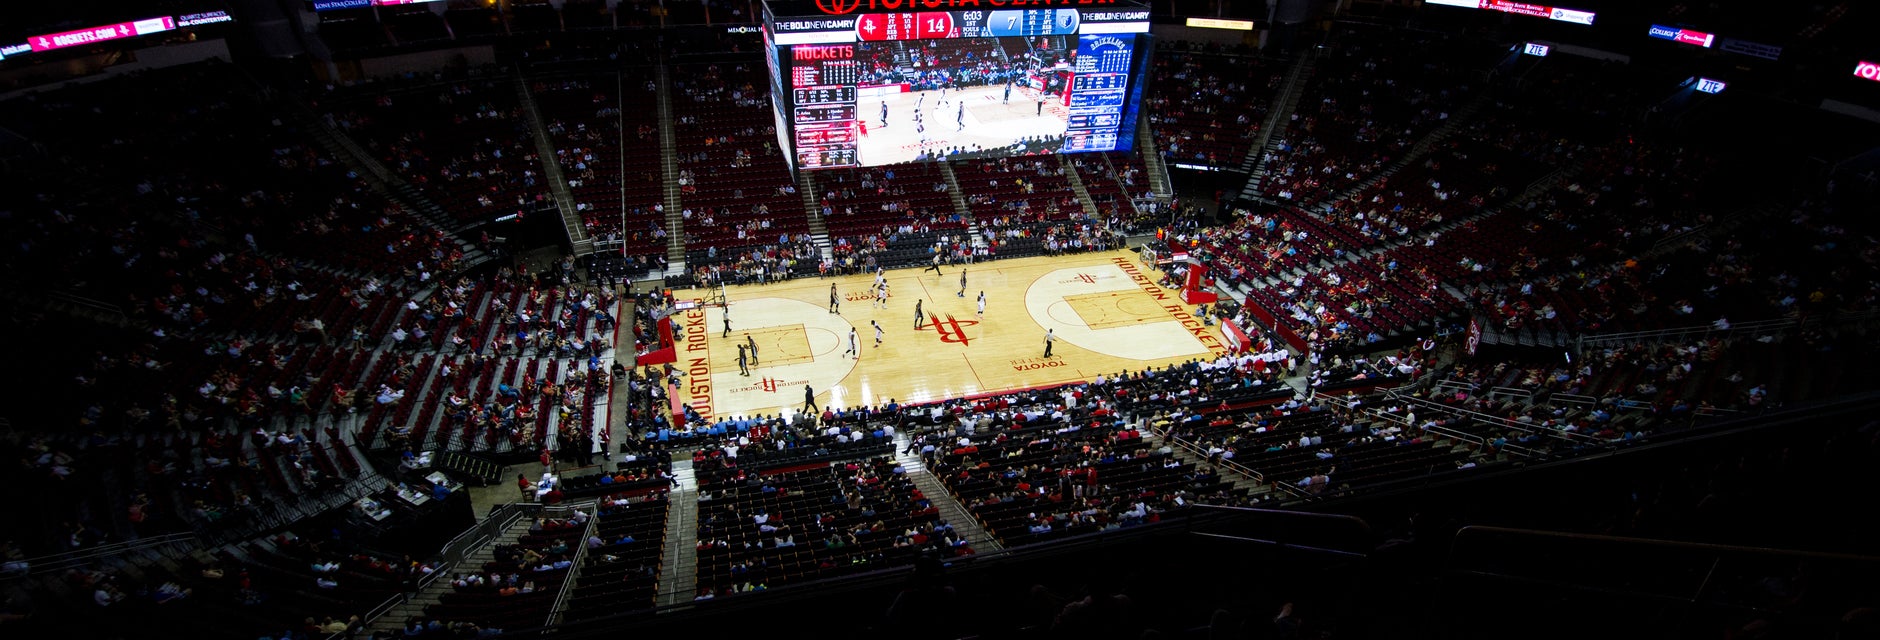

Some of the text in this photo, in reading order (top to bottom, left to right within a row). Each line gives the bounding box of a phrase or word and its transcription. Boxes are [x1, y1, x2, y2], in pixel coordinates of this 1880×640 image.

[963, 11, 982, 21] 6:03
[927, 18, 945, 33] 14
[1008, 17, 1017, 30] 7
[53, 27, 116, 46] ROCKETS.COM
[1651, 28, 1674, 37] COLLEGE
[795, 46, 854, 60] ROCKETS
[1529, 45, 1543, 56] ZTE
[1702, 81, 1719, 94] ZTE
[1111, 257, 1171, 301] HOUSTON
[1014, 361, 1068, 371] TOYOTA
